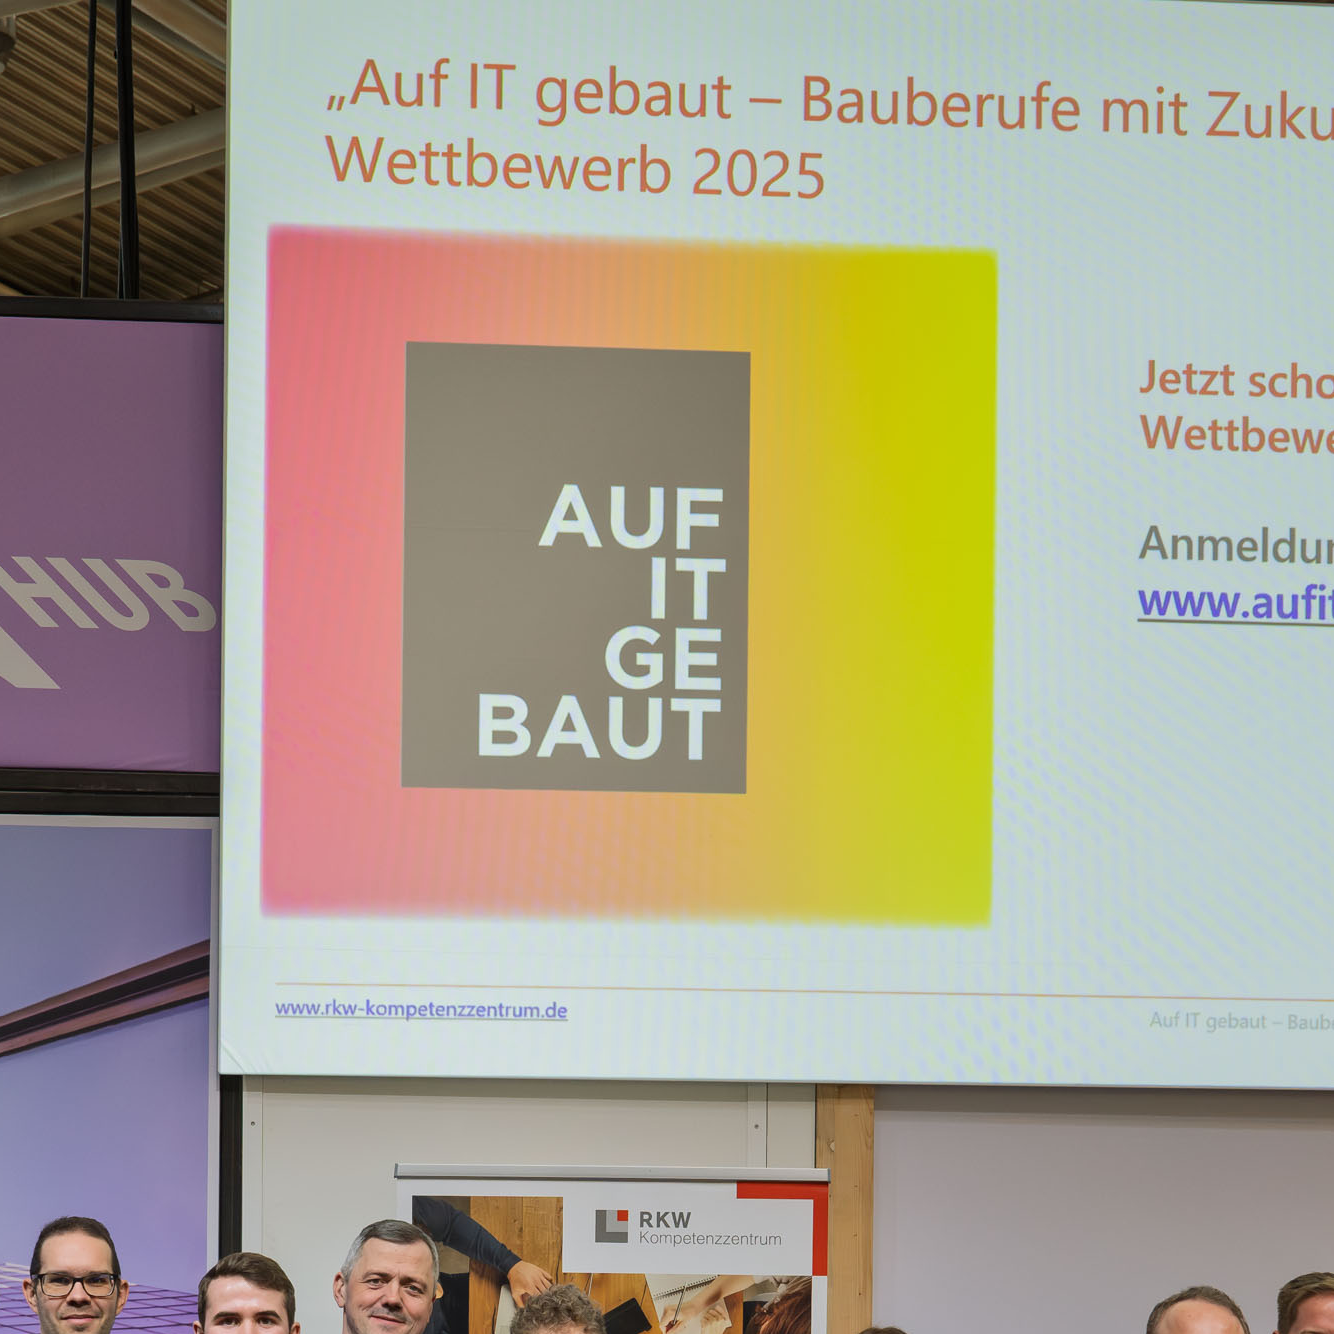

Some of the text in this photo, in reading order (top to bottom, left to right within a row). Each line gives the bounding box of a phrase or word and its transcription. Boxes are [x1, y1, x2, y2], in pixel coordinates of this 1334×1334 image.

[326, 57, 451, 112] „Auf
[470, 62, 517, 111] IT
[536, 64, 732, 127] gebaut
[803, 75, 1081, 132] Bauberufe
[1102, 85, 1189, 137] mit
[325, 131, 825, 200] Wettbewerb 2025
[1139, 359, 1236, 397] Jetzt
[538, 483, 724, 550] AUF
[650, 556, 727, 620] IT
[604, 624, 722, 691] GE
[478, 692, 722, 760] BAUT
[275, 999, 569, 1022] www.rkw-kompetenzzentrum.de
[1149, 1010, 1180, 1028] Auf
[1185, 1011, 1202, 1028] IT
[1205, 1013, 1267, 1034] gebaut
[638, 1230, 783, 1248] Kompetenzzentrum
[639, 1210, 692, 1229] RKW
